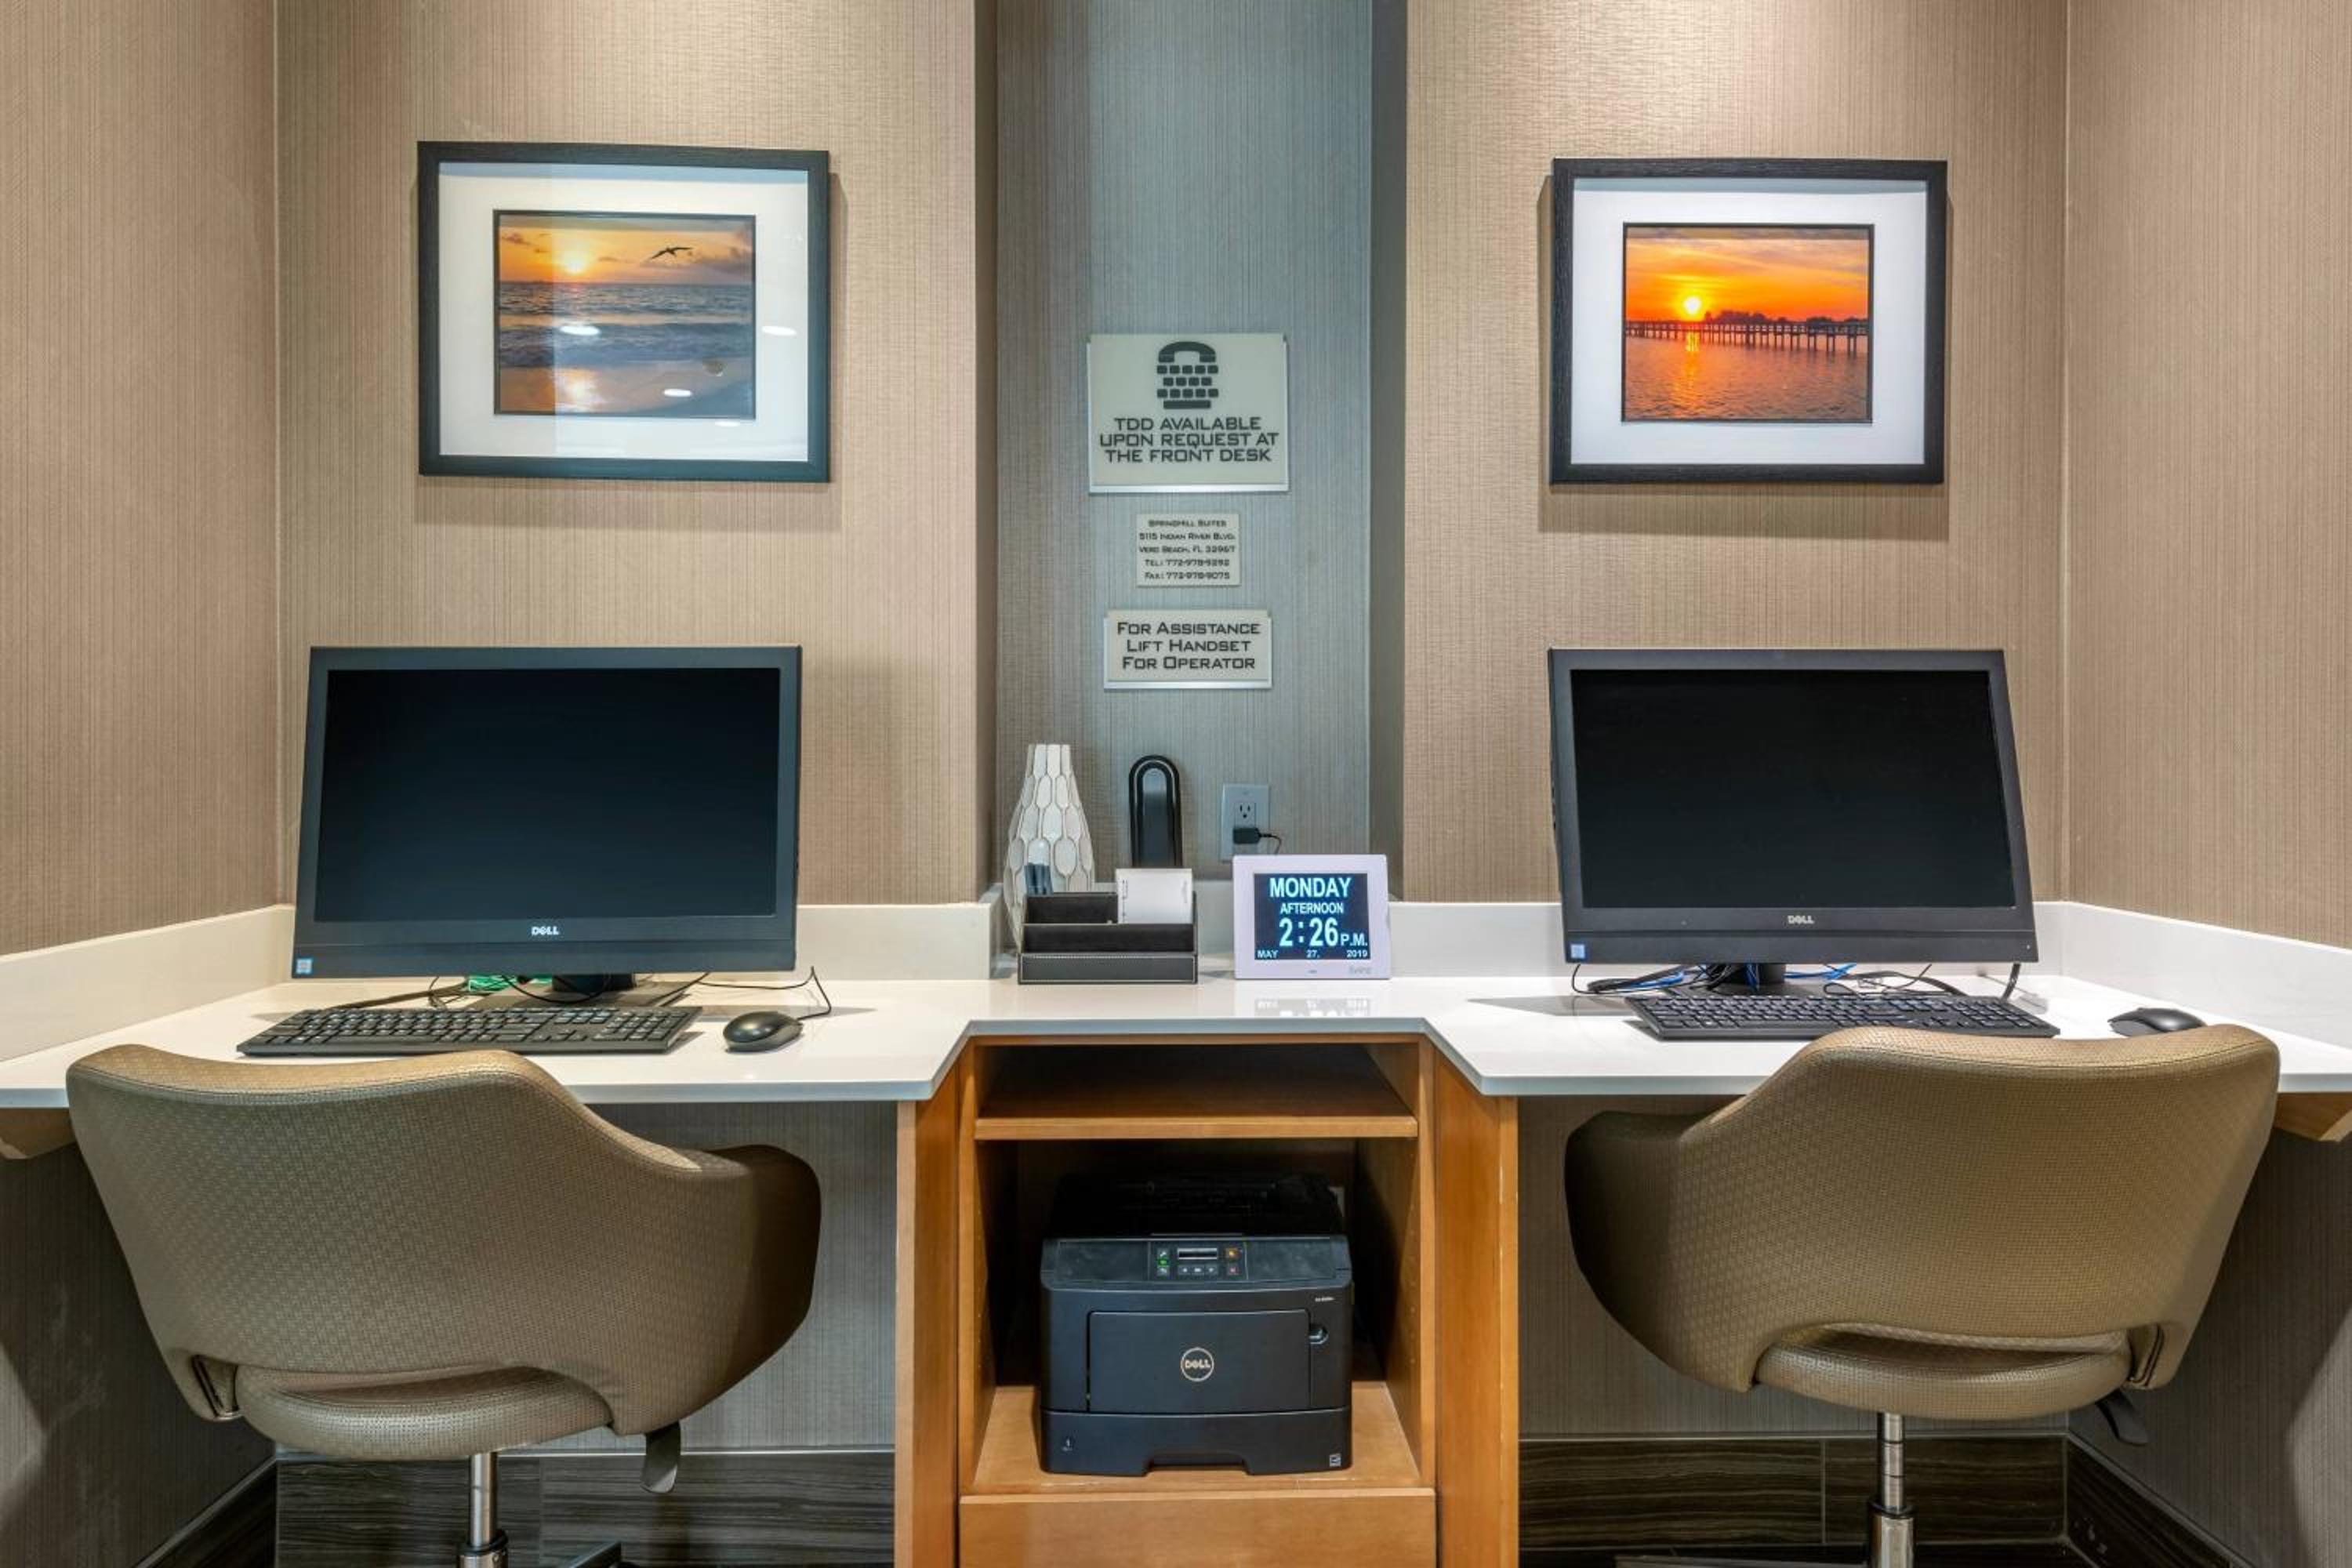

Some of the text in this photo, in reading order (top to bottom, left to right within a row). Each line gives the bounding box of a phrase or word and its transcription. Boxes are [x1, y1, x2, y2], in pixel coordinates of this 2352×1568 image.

[1114, 416, 1261, 431] TDD AVAILABLE
[1099, 432, 1279, 449] UPON REQUEST AT
[1105, 448, 1272, 463] THE FRONT DESK
[1117, 622, 1261, 635] FOR ASSISTANCE
[1127, 639, 1251, 652] LIFT HANDSET
[1122, 656, 1255, 670] FOR OPERATOR
[1269, 877, 1352, 898] MONDAY
[1280, 902, 1344, 914] AFTERNOON
[1788, 915, 1815, 924] DELL
[532, 926, 559, 935] DELL
[1279, 917, 1368, 947] 2:26 P.M.
[1257, 949, 1279, 958] MAY
[1346, 949, 1368, 958] 2019
[1185, 1359, 1210, 1369] DELL
